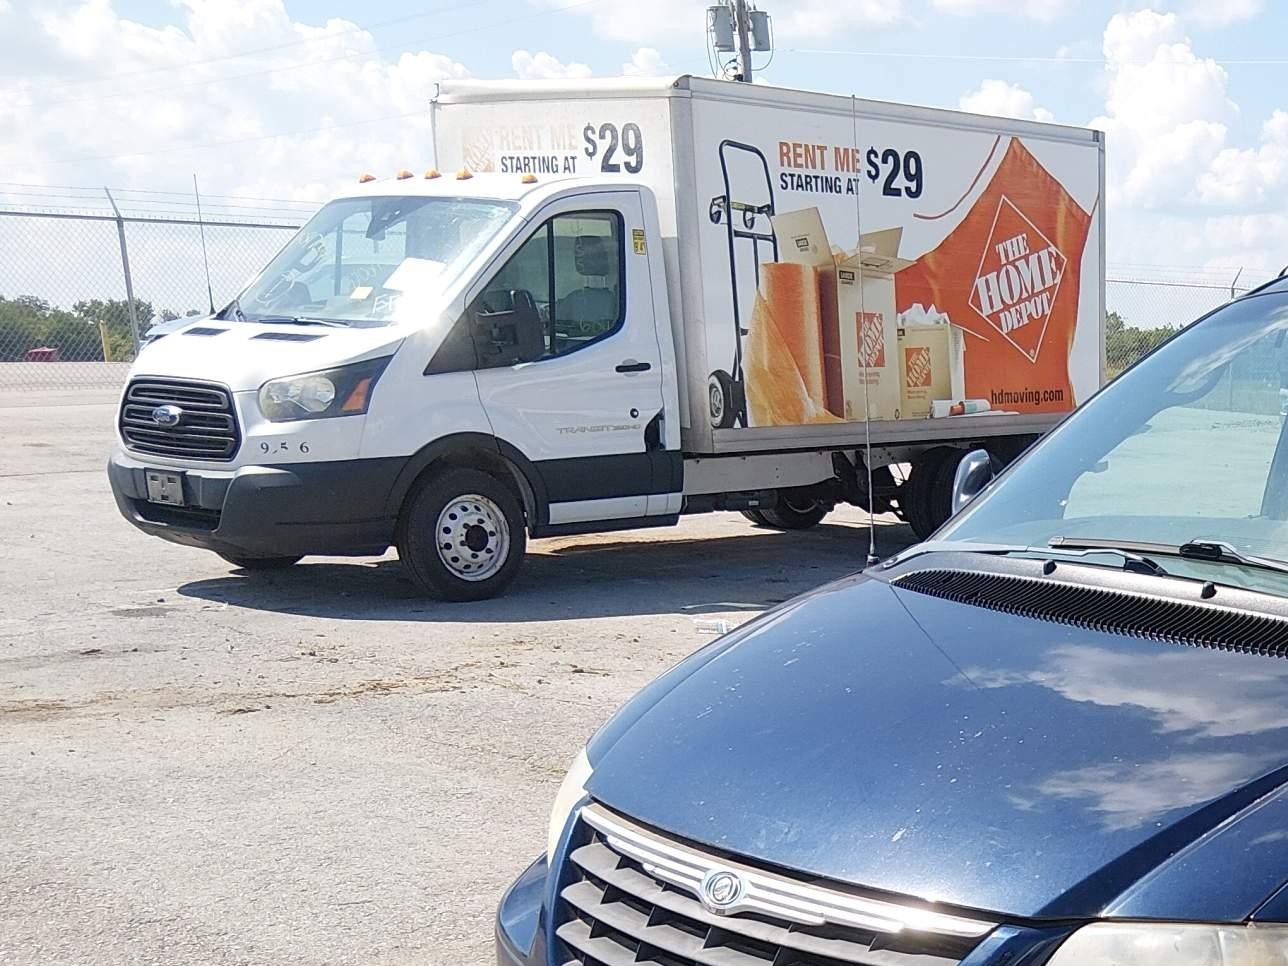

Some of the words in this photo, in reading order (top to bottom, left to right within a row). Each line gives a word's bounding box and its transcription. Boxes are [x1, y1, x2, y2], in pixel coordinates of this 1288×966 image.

[501, 126, 546, 150] RENT
[551, 126, 578, 150] ME
[583, 122, 644, 174] $29
[501, 155, 560, 175] STARTING
[563, 155, 578, 174] AT
[779, 141, 827, 170] RENT
[834, 147, 861, 173] ME
[866, 146, 923, 199] $29
[780, 172, 843, 195] STARTING
[846, 178, 860, 195] AT
[996, 233, 1030, 264] THE
[976, 247, 1060, 316] HOME
[1000, 292, 1051, 334] DEPOT
[991, 388, 1063, 405] hdmoving.com
